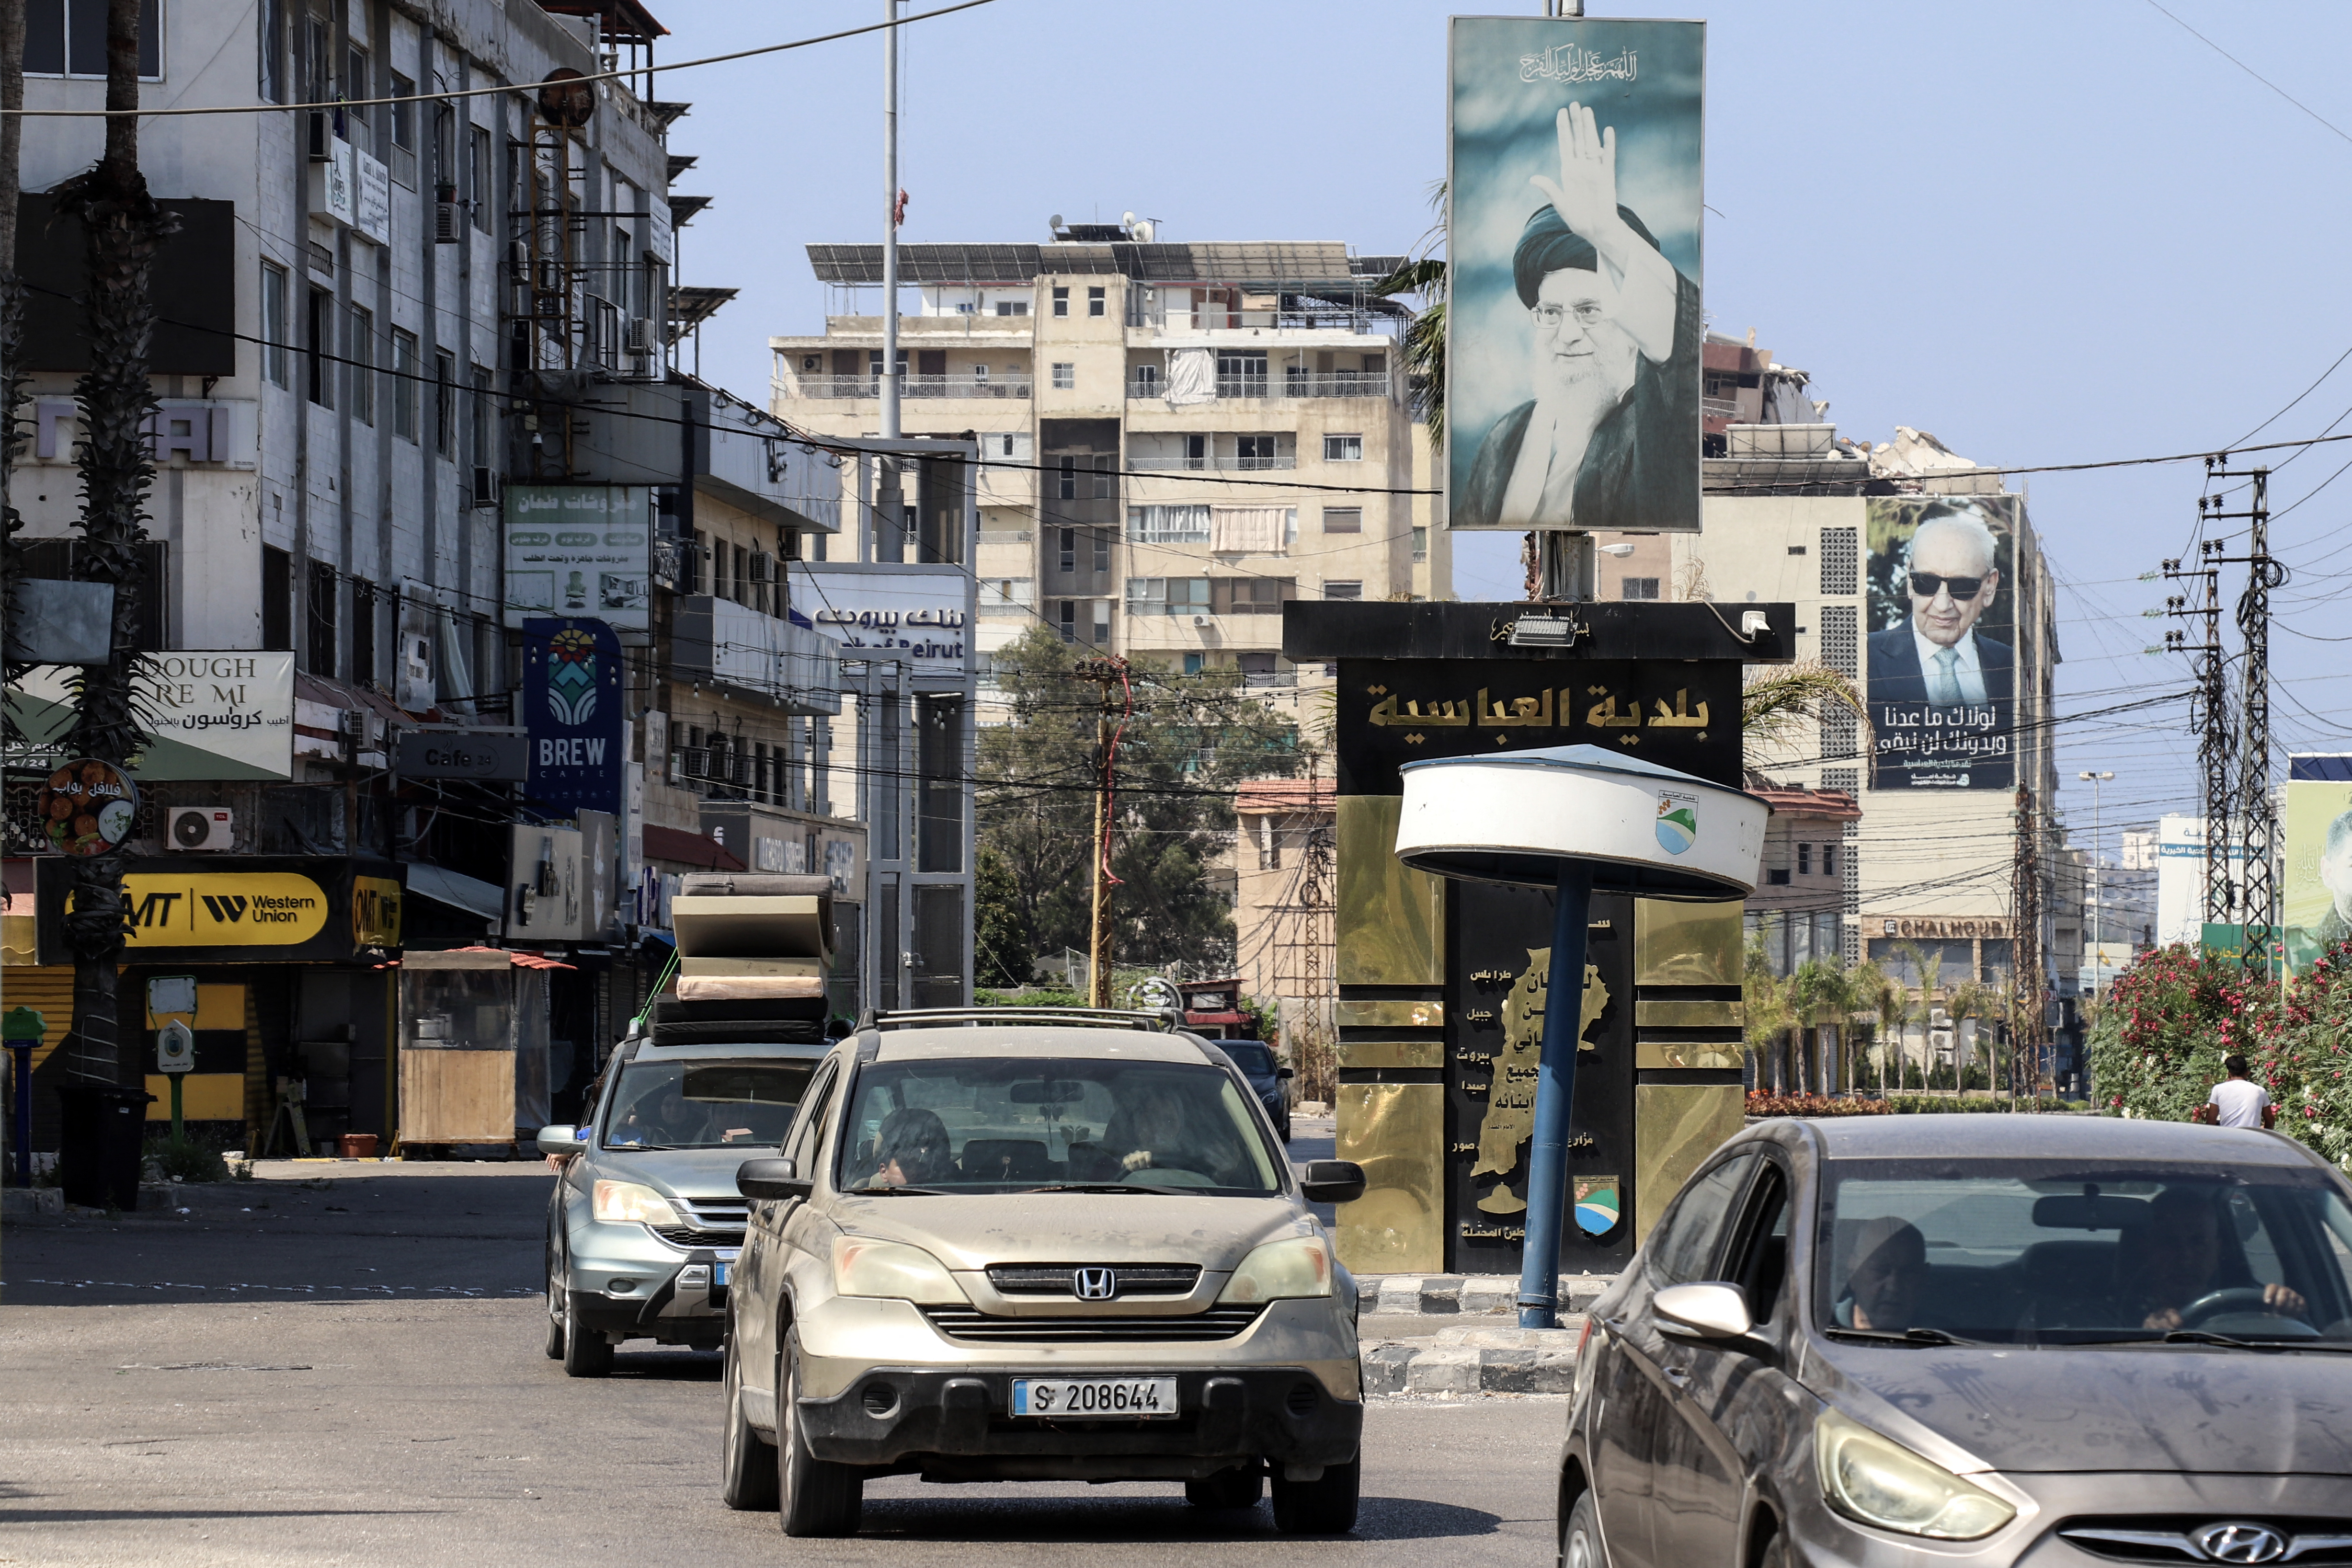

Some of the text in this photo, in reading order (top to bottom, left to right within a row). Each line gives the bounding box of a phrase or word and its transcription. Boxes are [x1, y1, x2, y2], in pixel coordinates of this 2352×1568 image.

[813, 608, 964, 635] بنك بيروت
[141, 658, 256, 678] DOUGH
[156, 684, 246, 708] RE MI
[1367, 685, 1709, 745] بلدية العباسية
[1885, 705, 1996, 732] لولاك ما عدنا
[1922, 730, 1940, 755] لن
[425, 748, 491, 767] Cafe 24
[539, 738, 606, 766] BREW
[29, 758, 47, 767] 24
[88, 781, 121, 798] فلافل
[2161, 845, 2186, 855] الخيرية
[120, 893, 182, 927] MT
[251, 895, 315, 908] Western
[252, 909, 297, 923] Union
[2204, 943, 2242, 961] لتجارية
[1470, 969, 1511, 983] طرابلس
[1466, 1008, 1493, 1021] جبيل
[1456, 1046, 1490, 1064] بيروت
[1506, 1066, 1540, 1083] جميع
[1461, 1080, 1486, 1094] صيدا
[1451, 1142, 1475, 1153] صور
[1065, 1383, 1158, 1411] 208644
